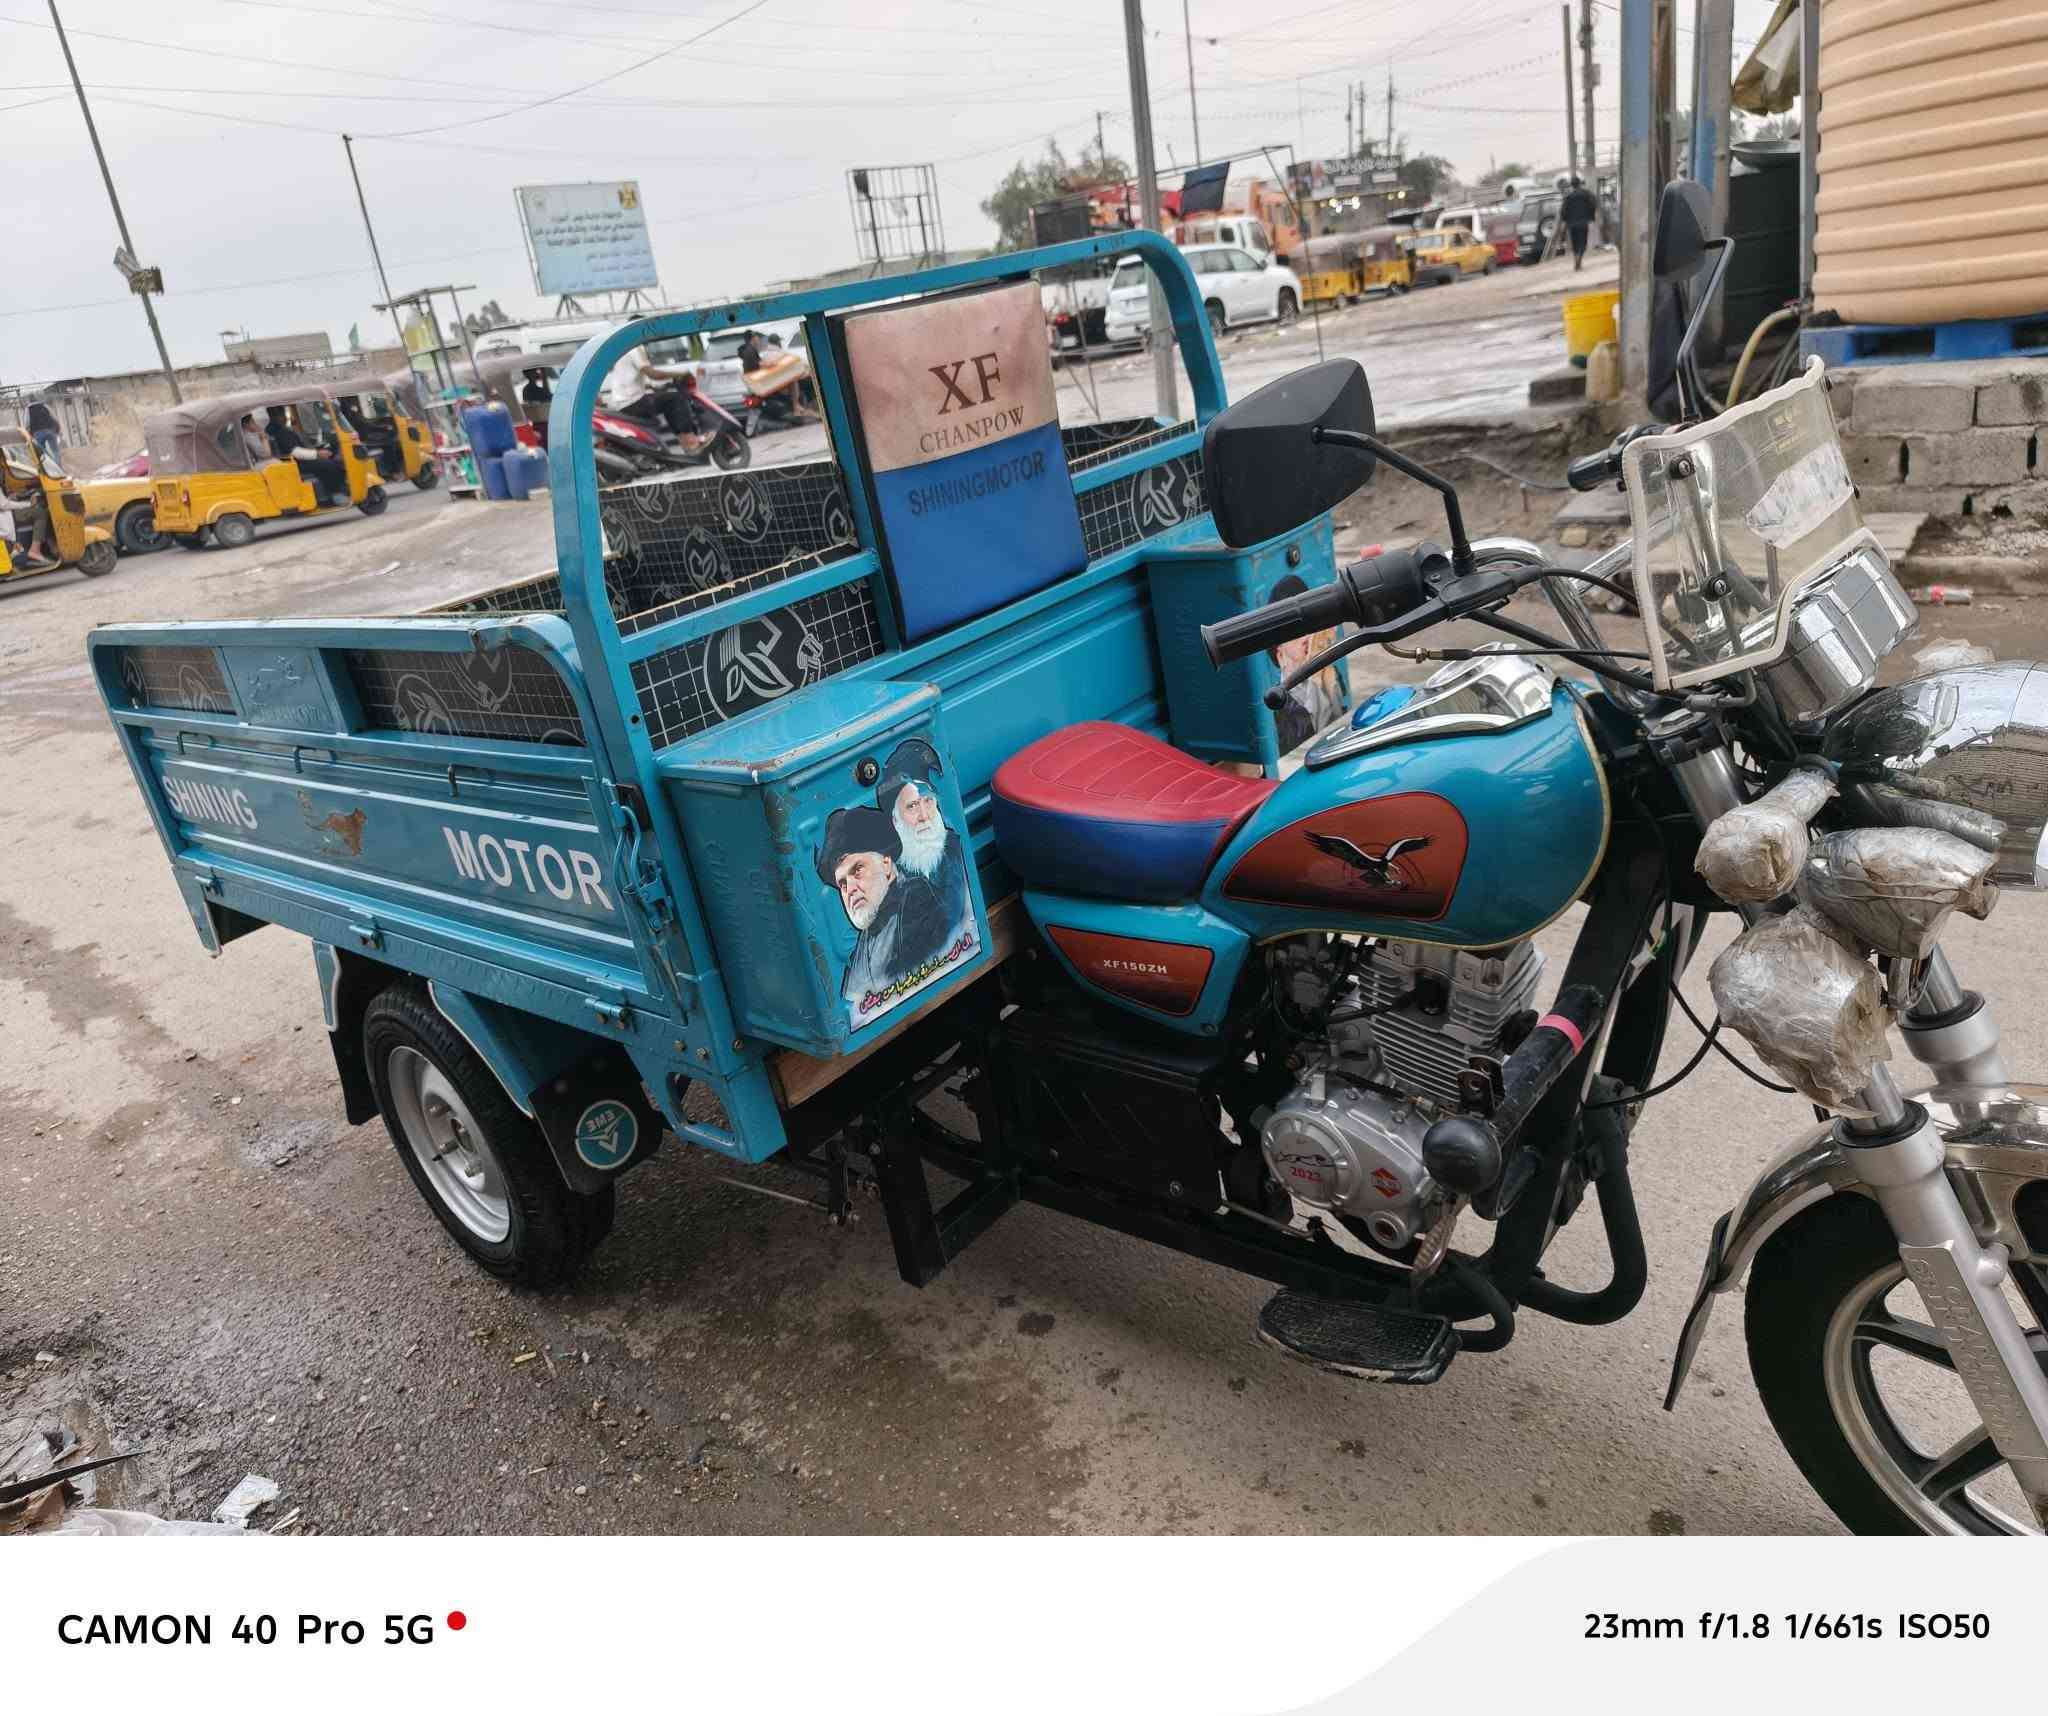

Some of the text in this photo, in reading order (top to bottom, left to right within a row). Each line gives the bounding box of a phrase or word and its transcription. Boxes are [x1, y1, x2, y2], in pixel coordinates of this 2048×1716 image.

[928, 351, 1001, 415] XF
[919, 405, 1025, 454] CHANPOW
[162, 775, 616, 912] SHINING MOTOR
[1103, 959, 1168, 974] XF150ZH
